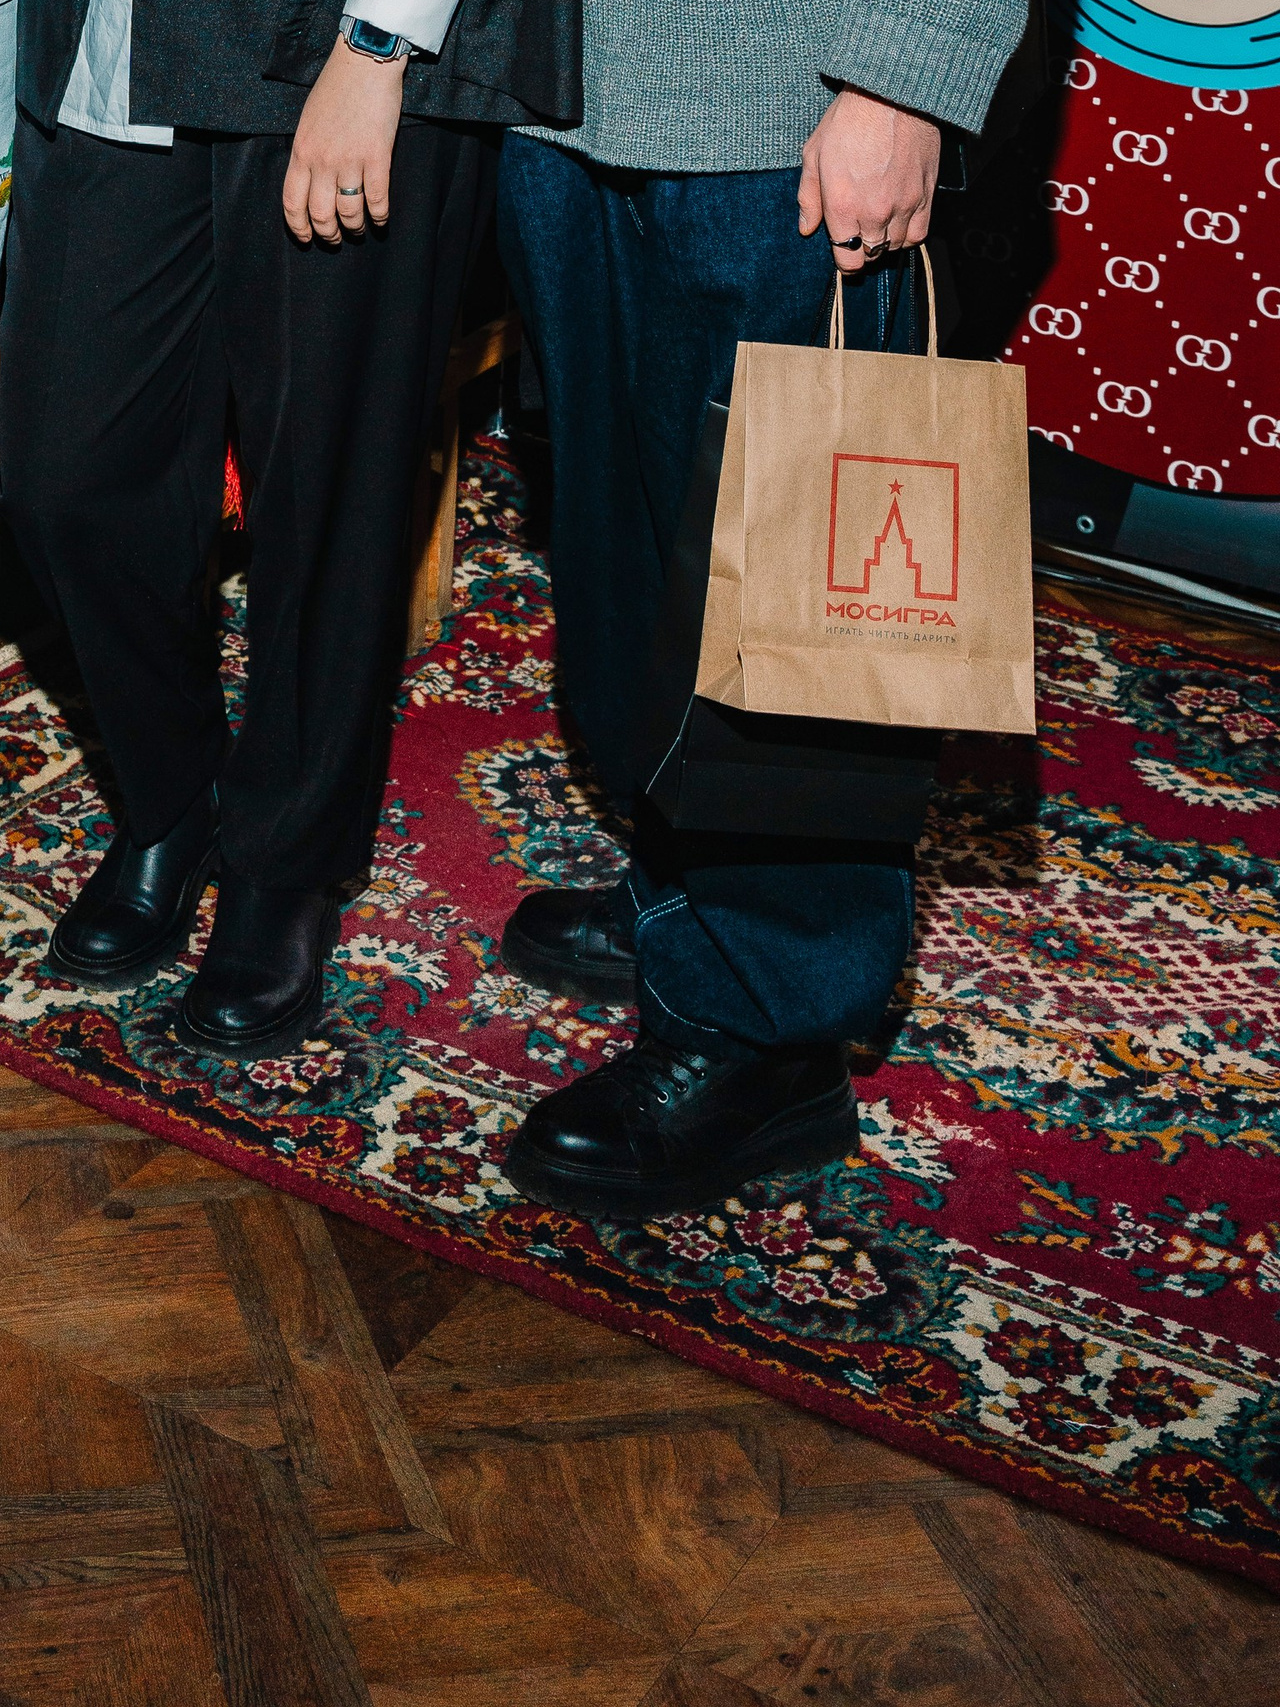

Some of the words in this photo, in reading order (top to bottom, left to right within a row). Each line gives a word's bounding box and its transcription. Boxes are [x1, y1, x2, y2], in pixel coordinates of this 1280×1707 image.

[825, 601, 957, 627] МОСИГРА
[825, 626, 864, 636] ИГРАТЬ
[868, 628, 909, 640] ЧИТАТЬ
[913, 632, 957, 644] ДАРИТЬ
